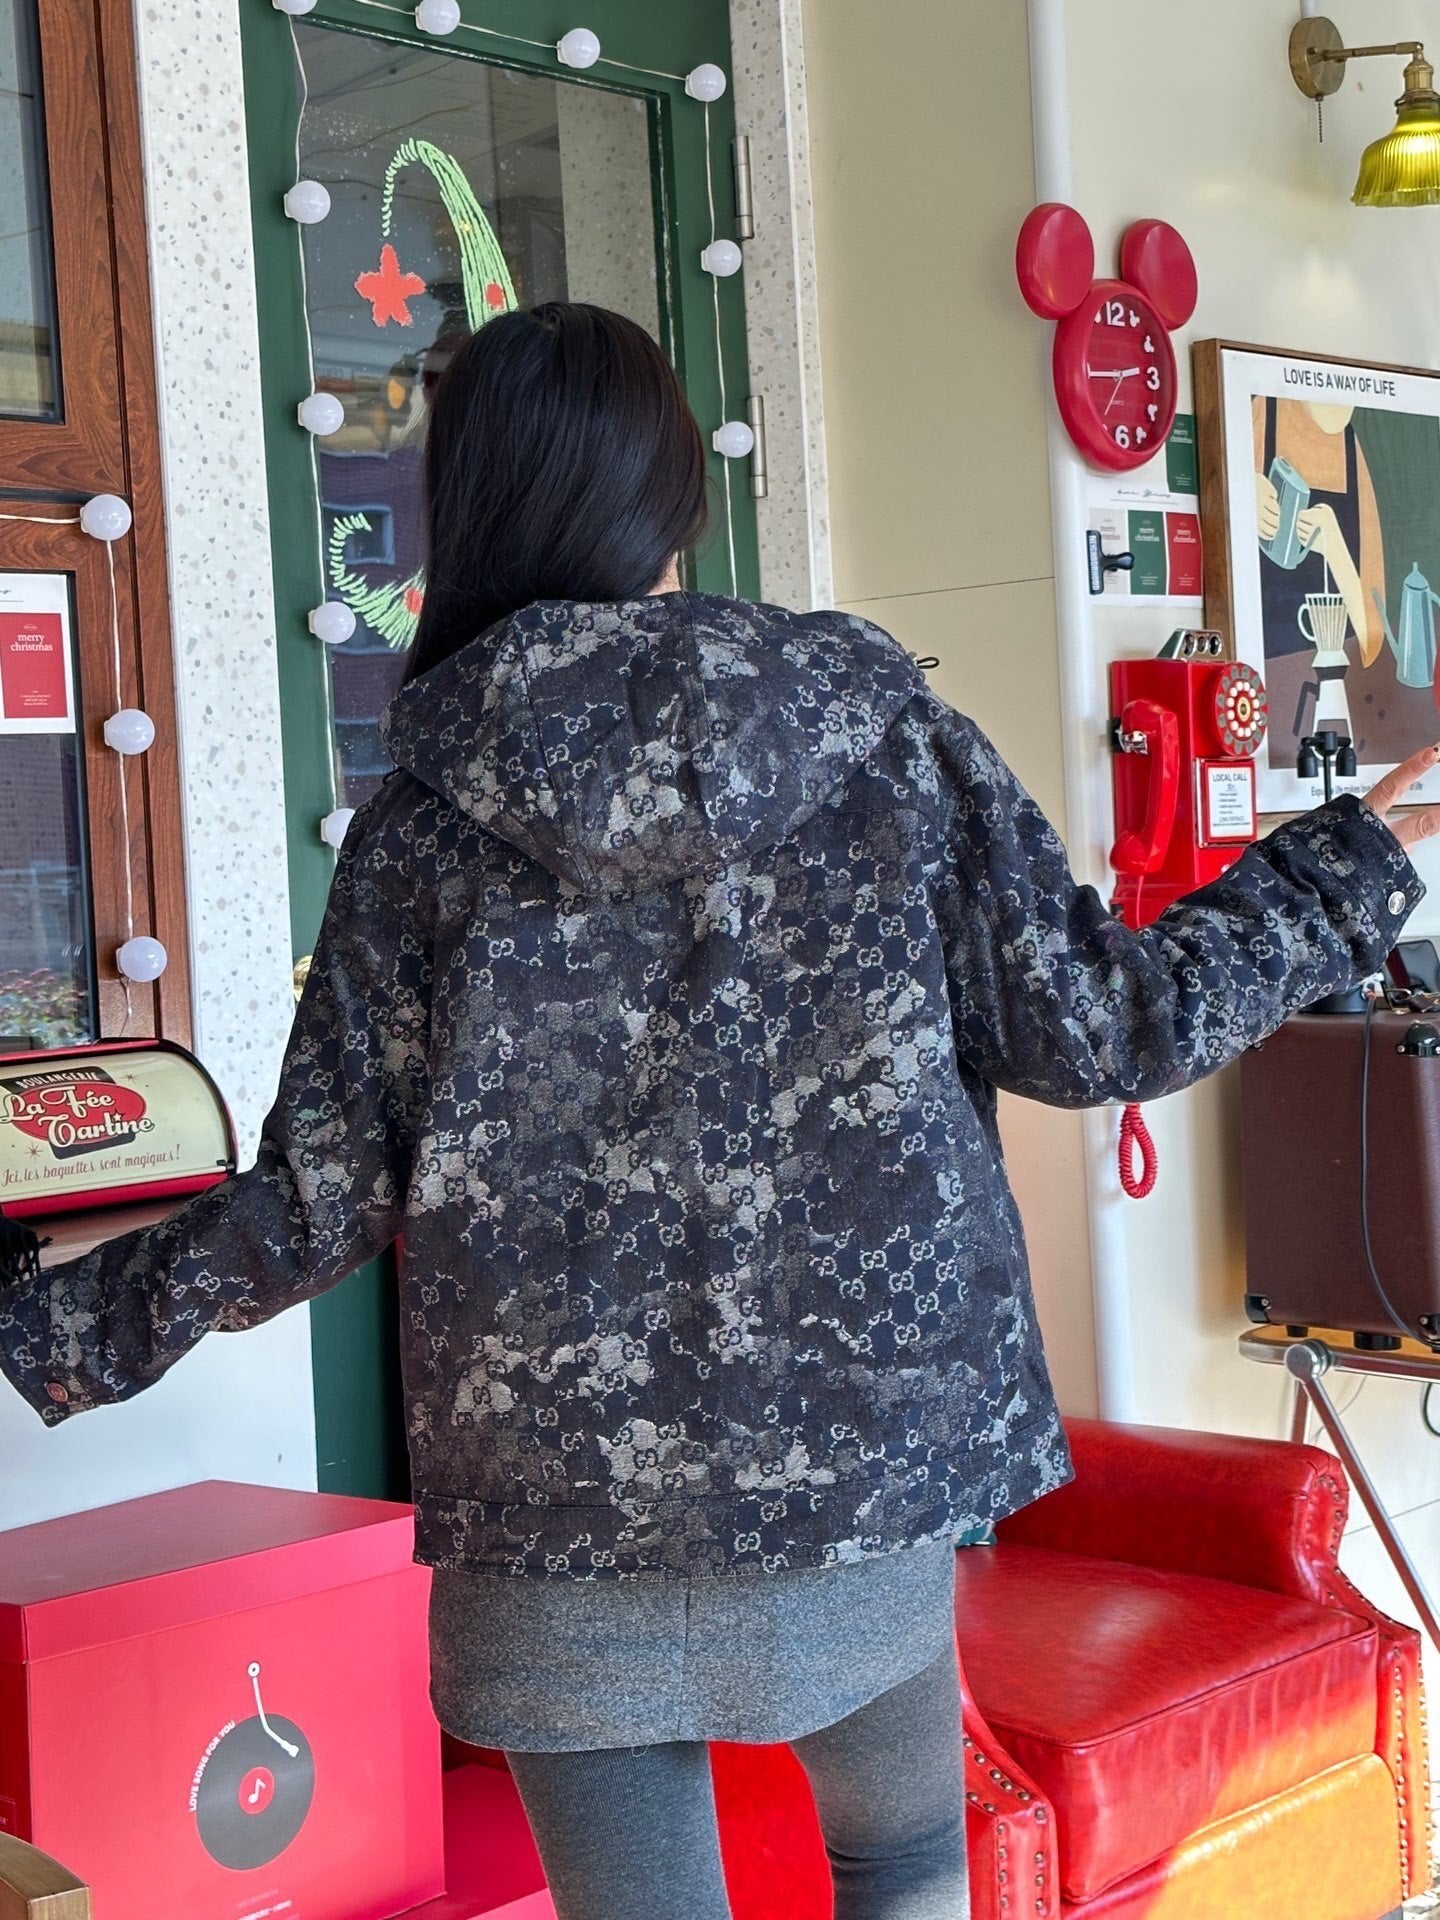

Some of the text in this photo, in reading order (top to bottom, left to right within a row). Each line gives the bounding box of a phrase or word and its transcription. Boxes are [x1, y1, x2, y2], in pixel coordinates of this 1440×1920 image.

[1106, 301, 1126, 327] 12
[1147, 367, 1160, 390] 3
[1283, 368, 1396, 396] LOVE IS A WAY OF LIFE
[1115, 425, 1130, 449] 6
[10, 642, 54, 652] christmas
[17, 634, 45, 644] merry
[1212, 773, 1248, 782] LOCAL CALL
[15, 1072, 100, 1089] BOULANGERIE
[0, 1085, 116, 1122] La Fée
[37, 1111, 154, 1148] Tartine
[24, 1169, 40, 1181] les
[43, 1160, 95, 1180] baguettes
[100, 1154, 122, 1170] sont
[189, 1720, 236, 1812] LOVE SONG FOR YOU
